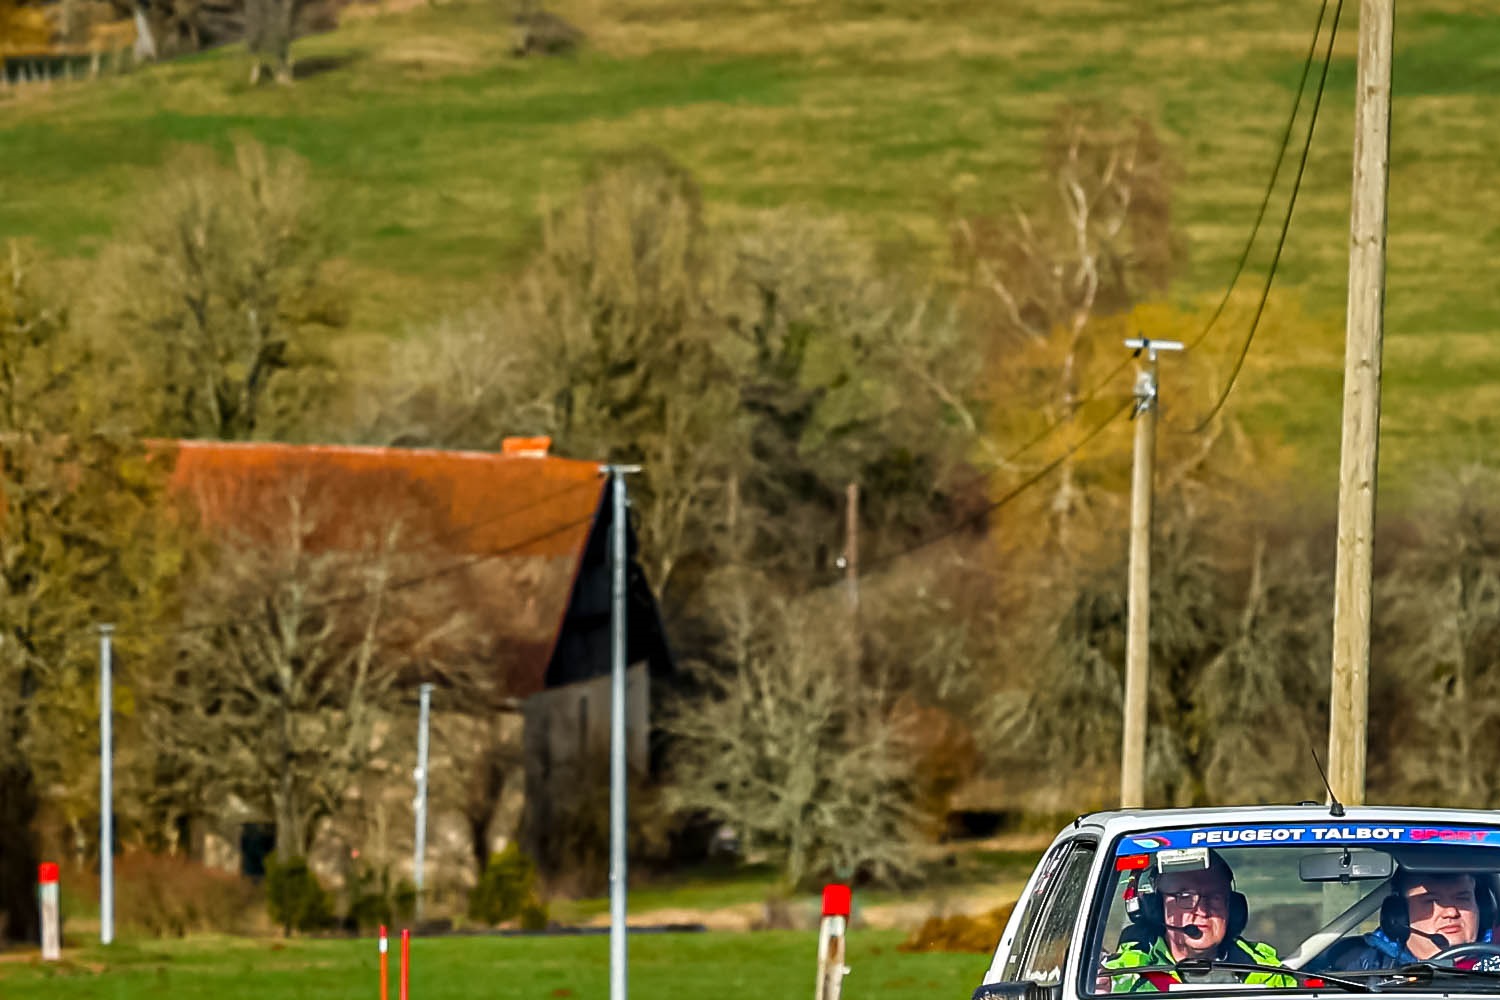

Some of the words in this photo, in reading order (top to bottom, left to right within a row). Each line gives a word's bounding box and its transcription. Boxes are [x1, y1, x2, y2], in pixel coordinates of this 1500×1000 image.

[1191, 829, 1305, 845] PEUGEOT
[1311, 828, 1404, 840] TALBOT
[1409, 829, 1489, 842] SPORT
